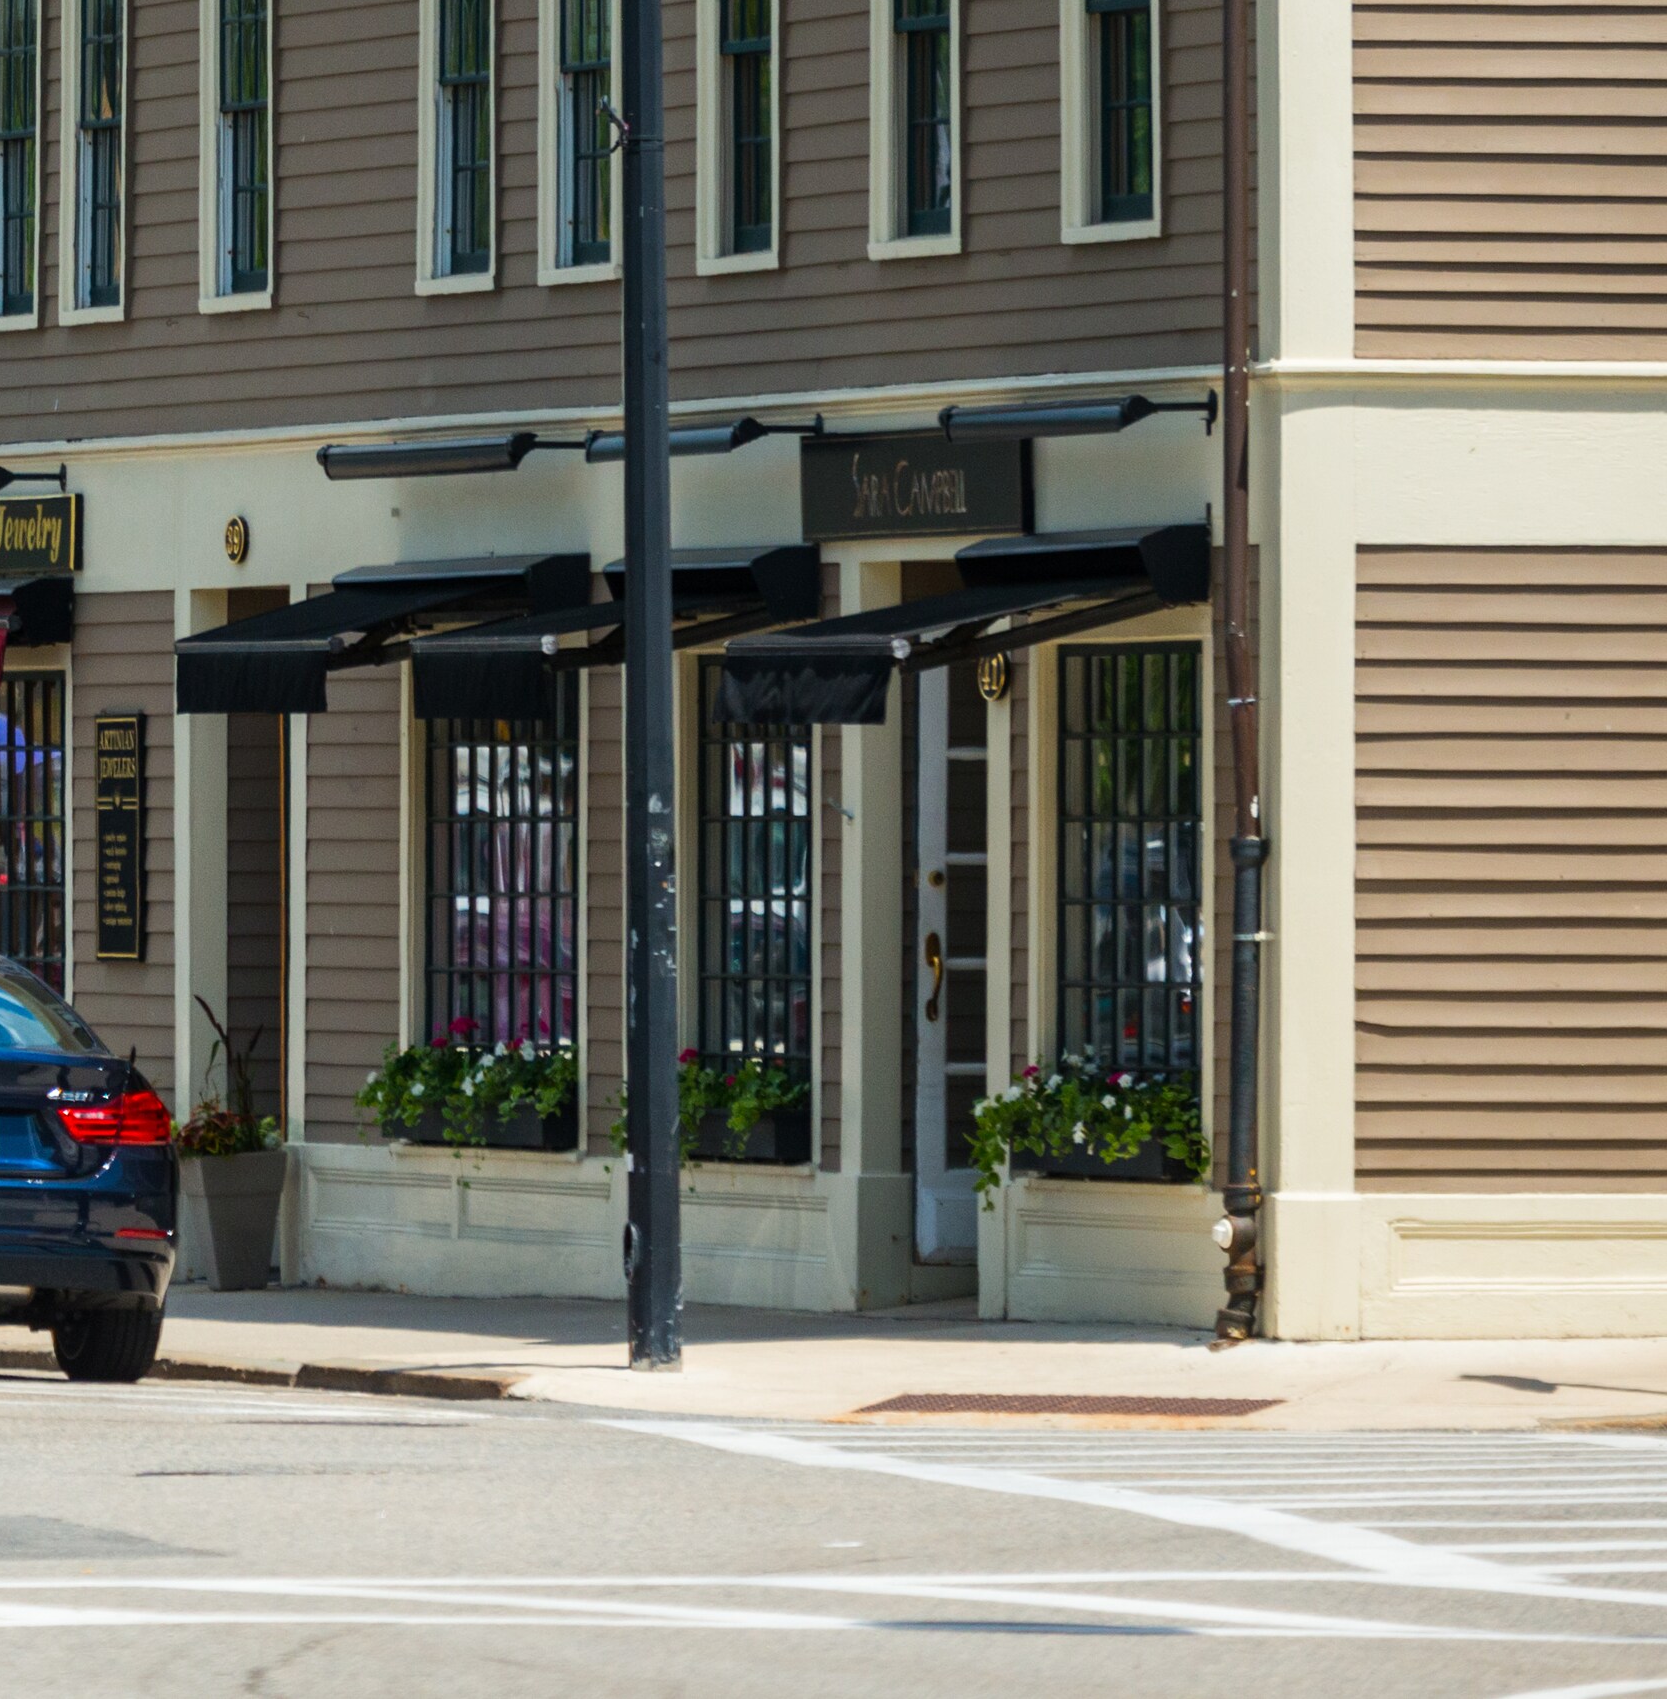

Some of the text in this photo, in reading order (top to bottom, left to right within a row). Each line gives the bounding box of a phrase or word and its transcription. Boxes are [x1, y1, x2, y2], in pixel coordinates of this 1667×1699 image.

[852, 453, 967, 517] SARA CAMPBELL
[228, 526, 240, 554] 39
[981, 657, 999, 690] 41
[99, 730, 135, 750] ARTINIAN
